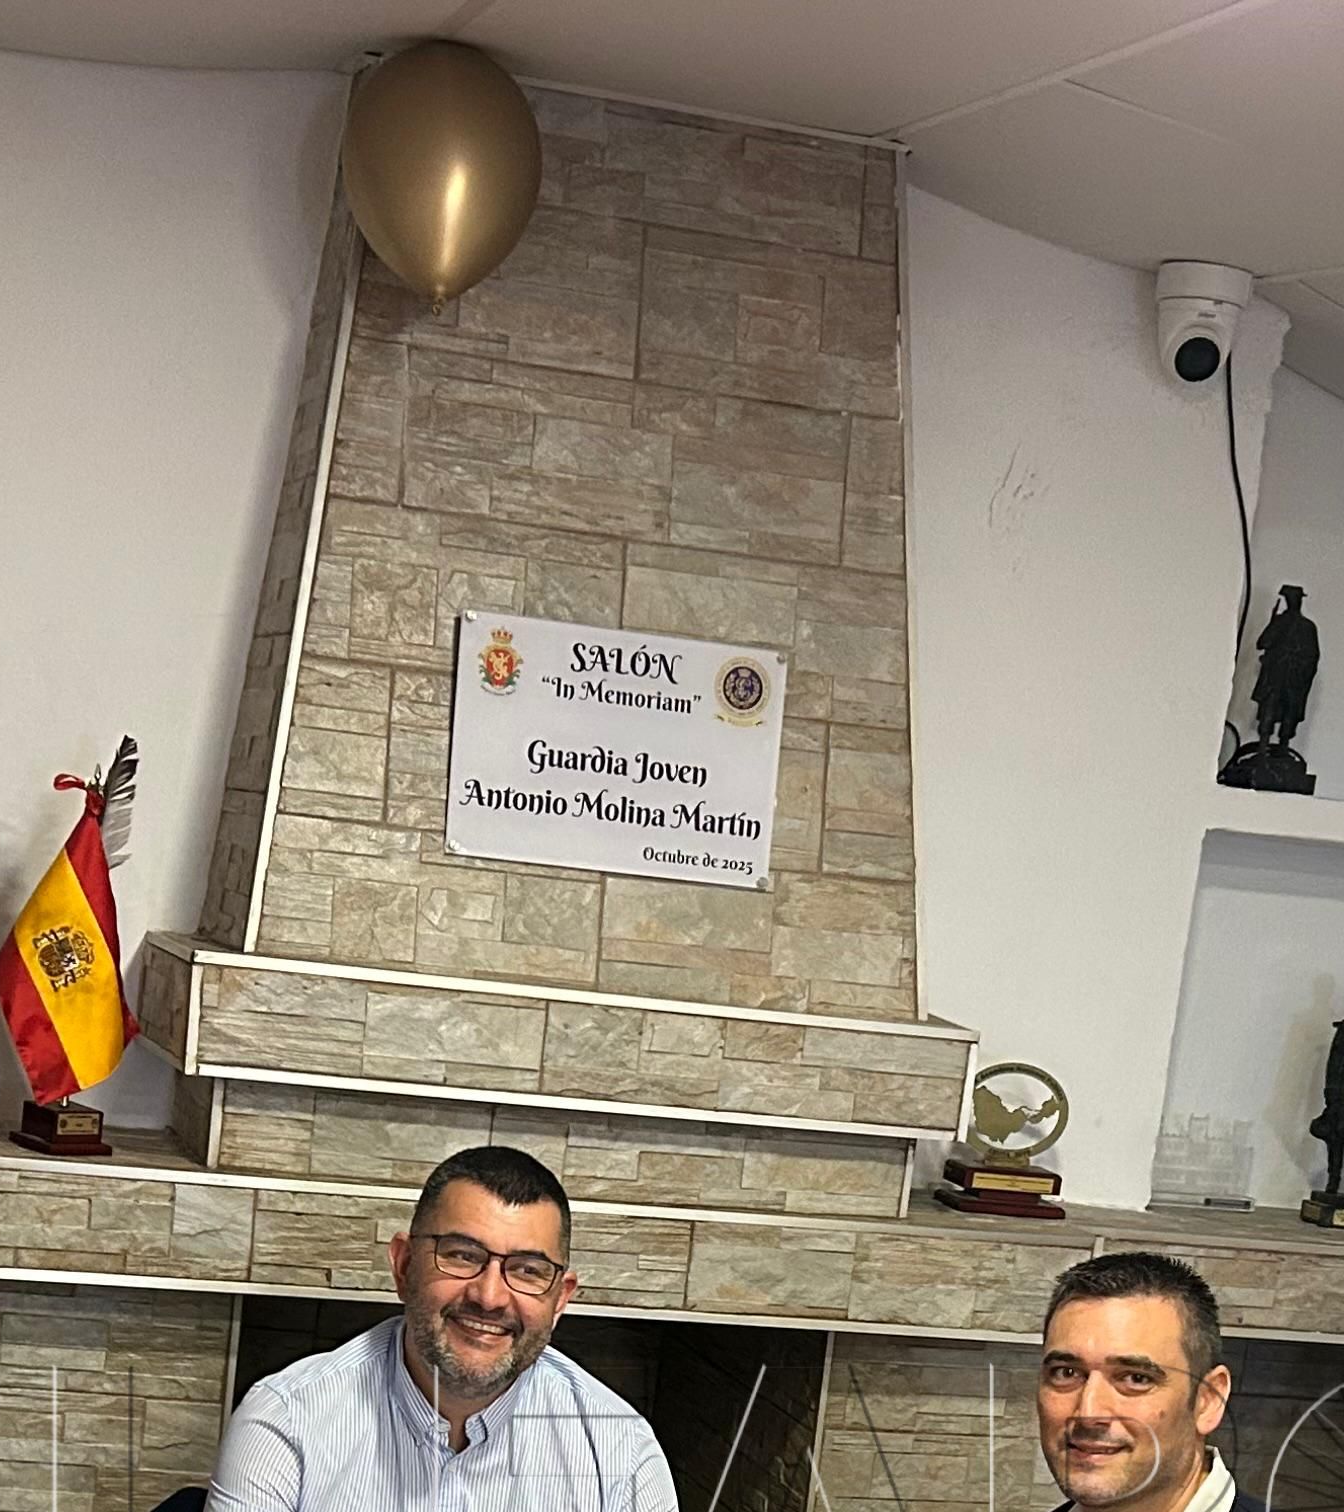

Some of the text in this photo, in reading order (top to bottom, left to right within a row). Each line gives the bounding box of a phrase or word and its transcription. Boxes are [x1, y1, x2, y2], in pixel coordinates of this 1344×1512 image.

[570, 643, 682, 685] SALÓN
[528, 739, 708, 788] Guardia Joven
[459, 779, 761, 840] Antonio Molina Martín
[642, 847, 754, 875] Octubre de 2025
